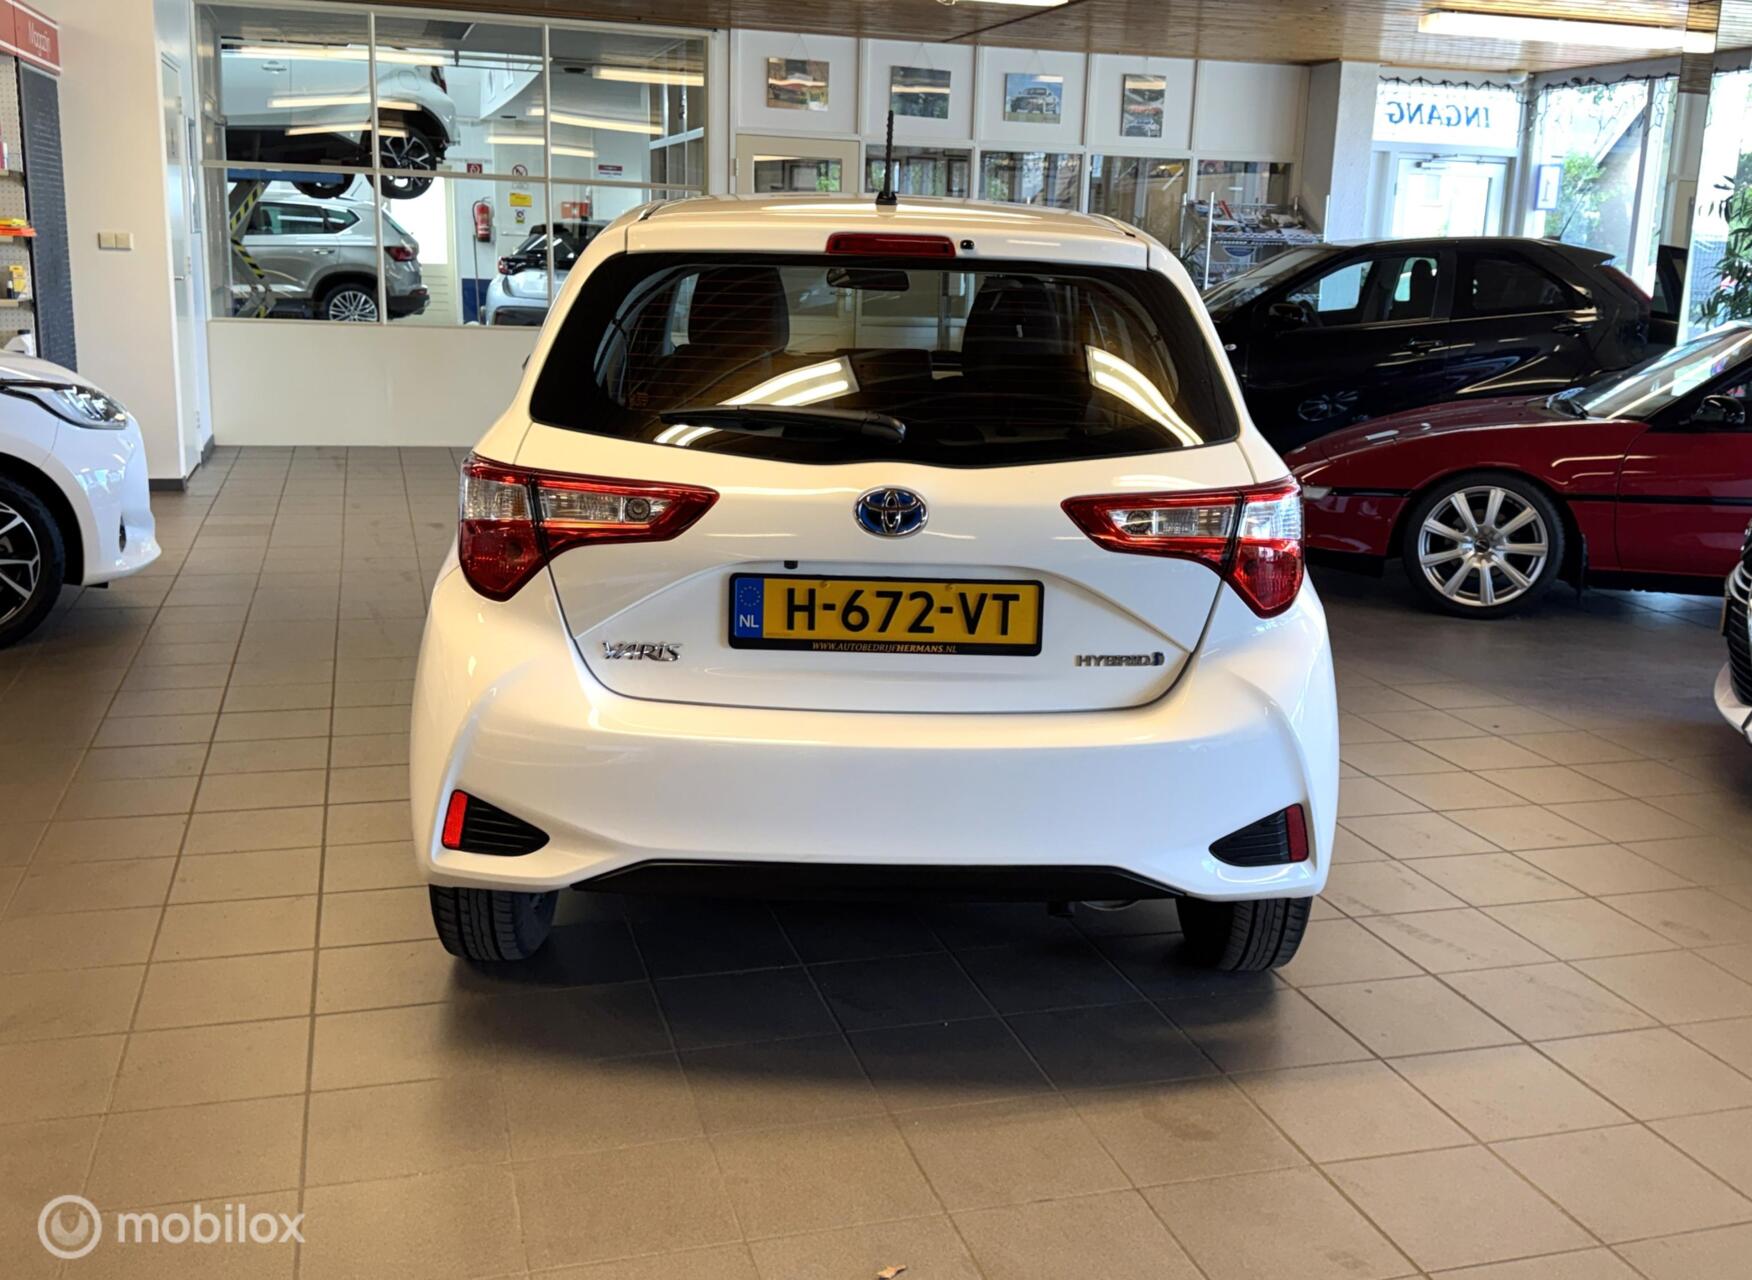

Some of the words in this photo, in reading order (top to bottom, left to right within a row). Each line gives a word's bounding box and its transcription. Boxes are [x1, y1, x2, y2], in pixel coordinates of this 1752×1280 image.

[786, 588, 1021, 636] H-672-VT
[739, 615, 759, 628] NL
[811, 641, 957, 653] WWW.AUTOBEDRIJFHERMANS.NL
[1074, 654, 1152, 667] HYBRID
